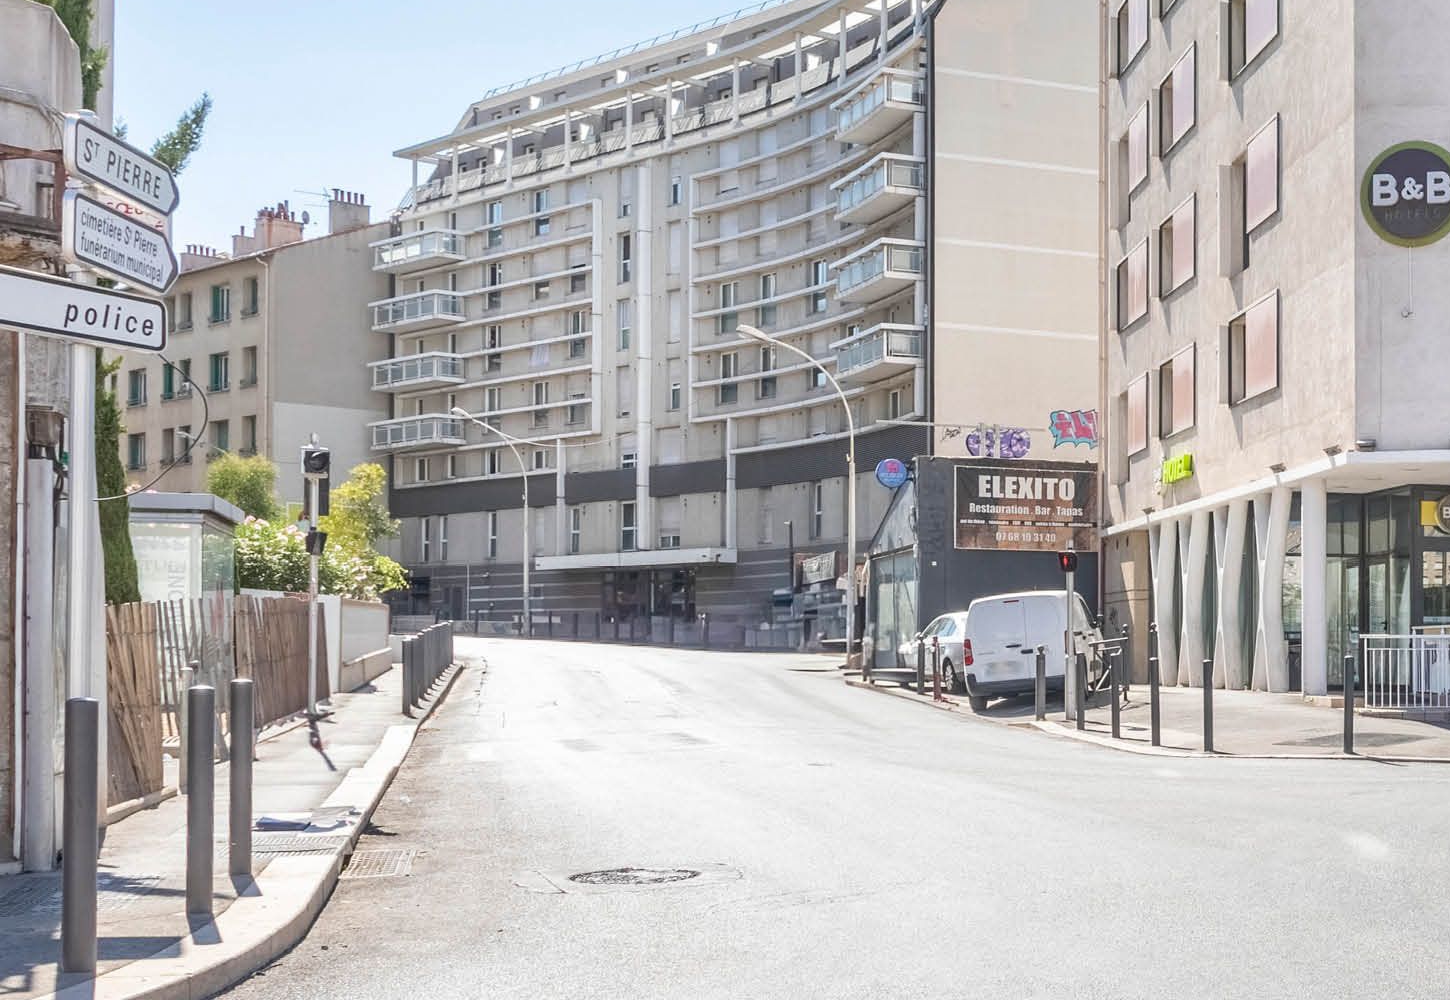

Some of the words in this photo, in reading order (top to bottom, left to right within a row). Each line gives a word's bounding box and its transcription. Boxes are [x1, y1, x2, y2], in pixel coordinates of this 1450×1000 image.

[106, 150, 161, 199] PIERRE
[81, 208, 122, 241] cimetière
[133, 230, 157, 257] Pierre
[81, 232, 125, 267] funérarium
[126, 256, 164, 285] municipal
[64, 303, 154, 336] police
[978, 475, 1075, 501] ELEXITO
[969, 502, 1029, 515] Restauration
[1035, 505, 1051, 516] Bar
[1056, 506, 1083, 517] Tapas
[995, 532, 1005, 541] 07
